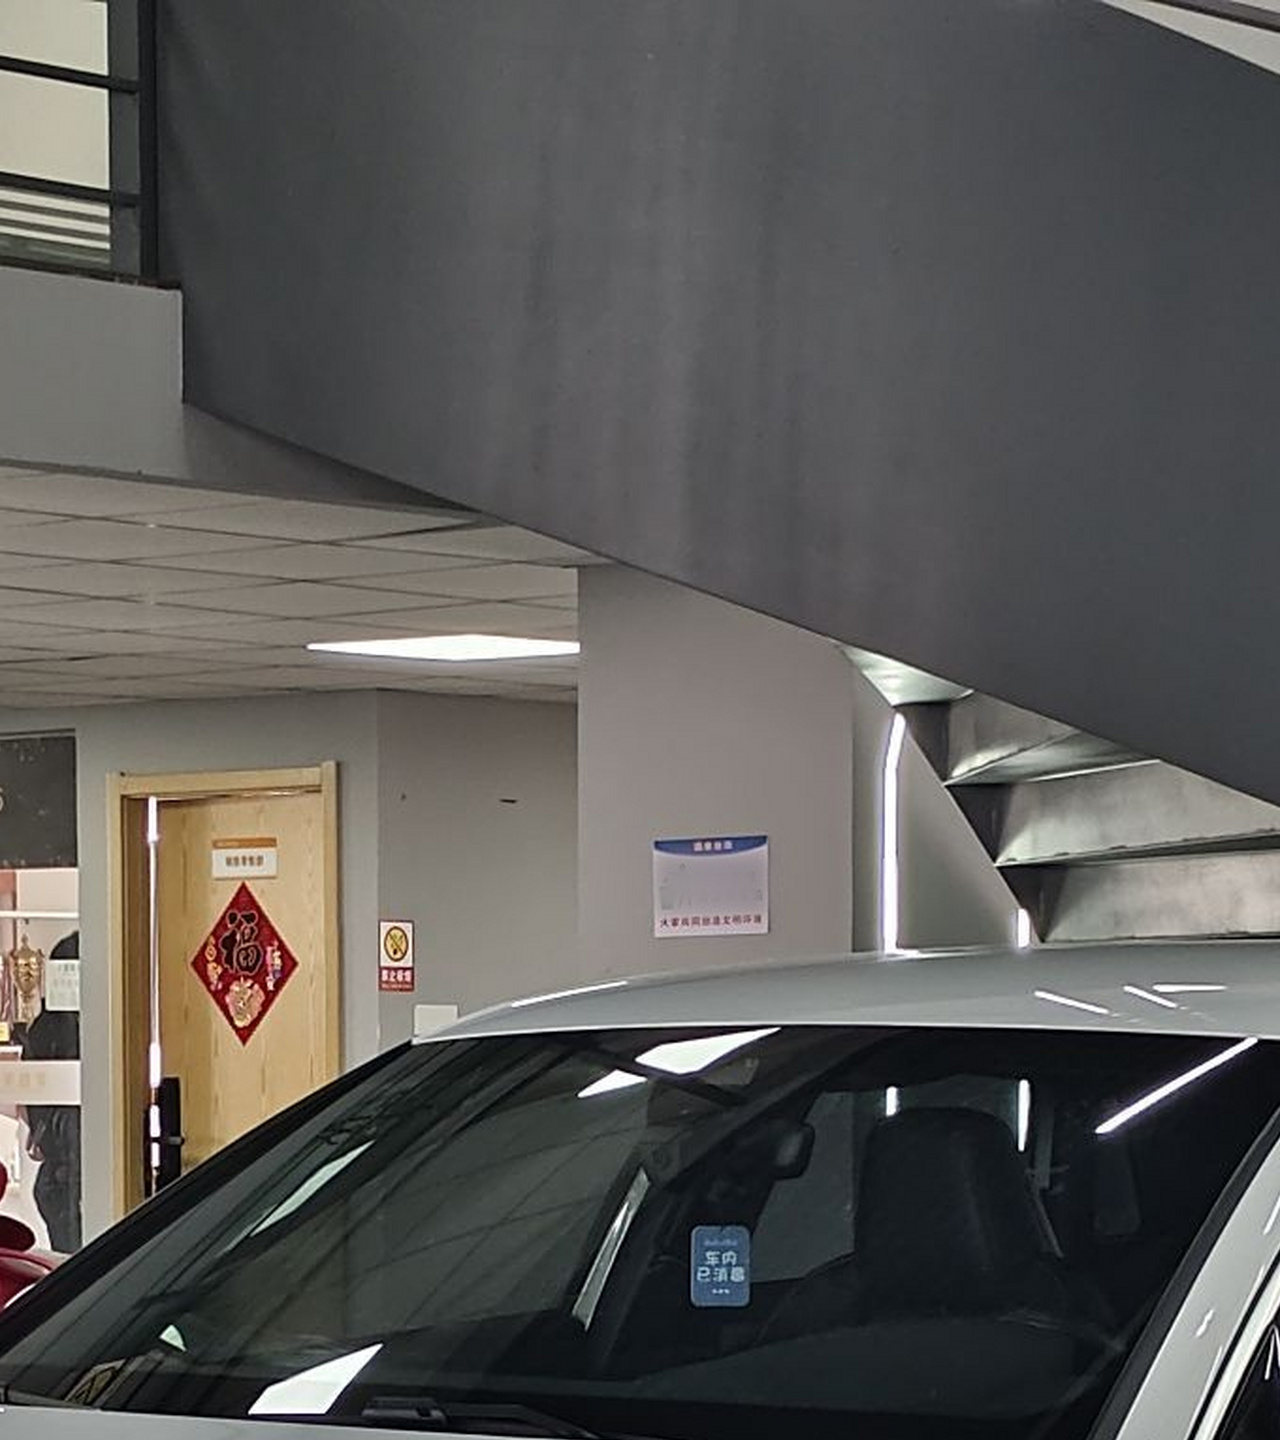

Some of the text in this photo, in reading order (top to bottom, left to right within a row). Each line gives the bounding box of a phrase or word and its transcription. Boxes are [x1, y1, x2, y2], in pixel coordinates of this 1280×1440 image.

[219, 910, 263, 976] 福
[704, 1250, 737, 1266] 车内
[697, 1266, 745, 1282] 已消毒
